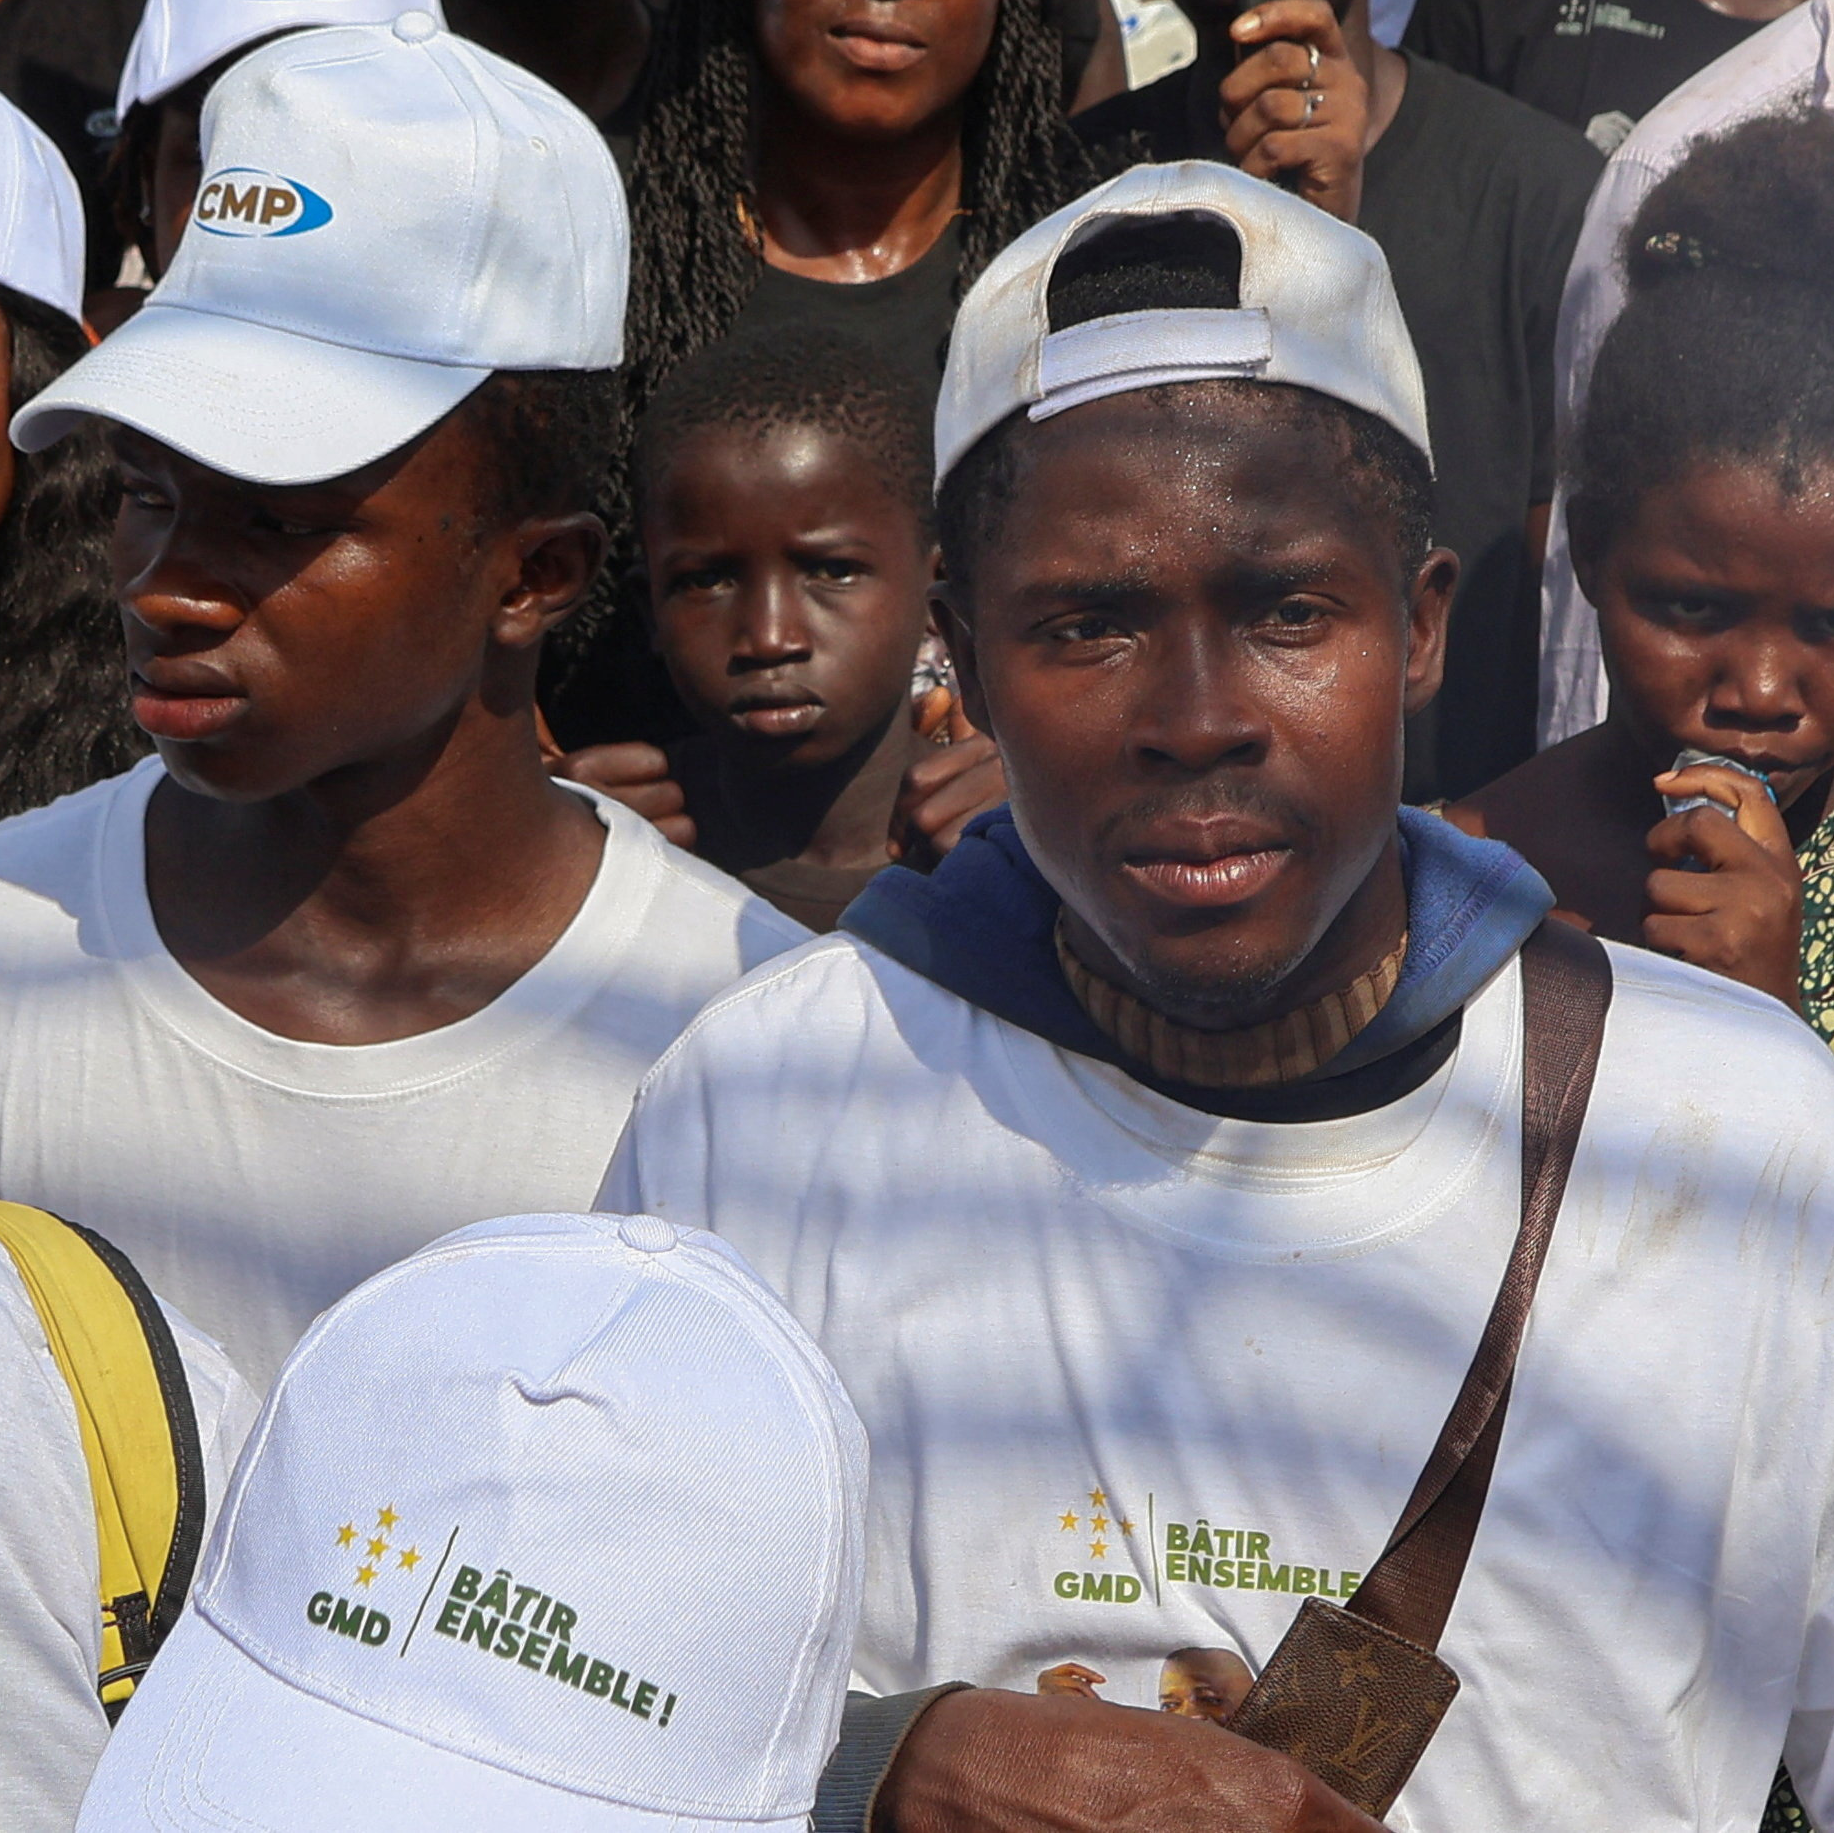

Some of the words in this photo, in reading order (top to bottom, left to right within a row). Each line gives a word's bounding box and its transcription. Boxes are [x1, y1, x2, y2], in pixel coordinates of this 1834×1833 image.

[196, 182, 297, 226] CMP
[1167, 1518, 1271, 1561] BÂTIR
[446, 1562, 580, 1646] BÂTIR
[1053, 1571, 1143, 1604] GMD
[305, 1590, 393, 1649] GMD
